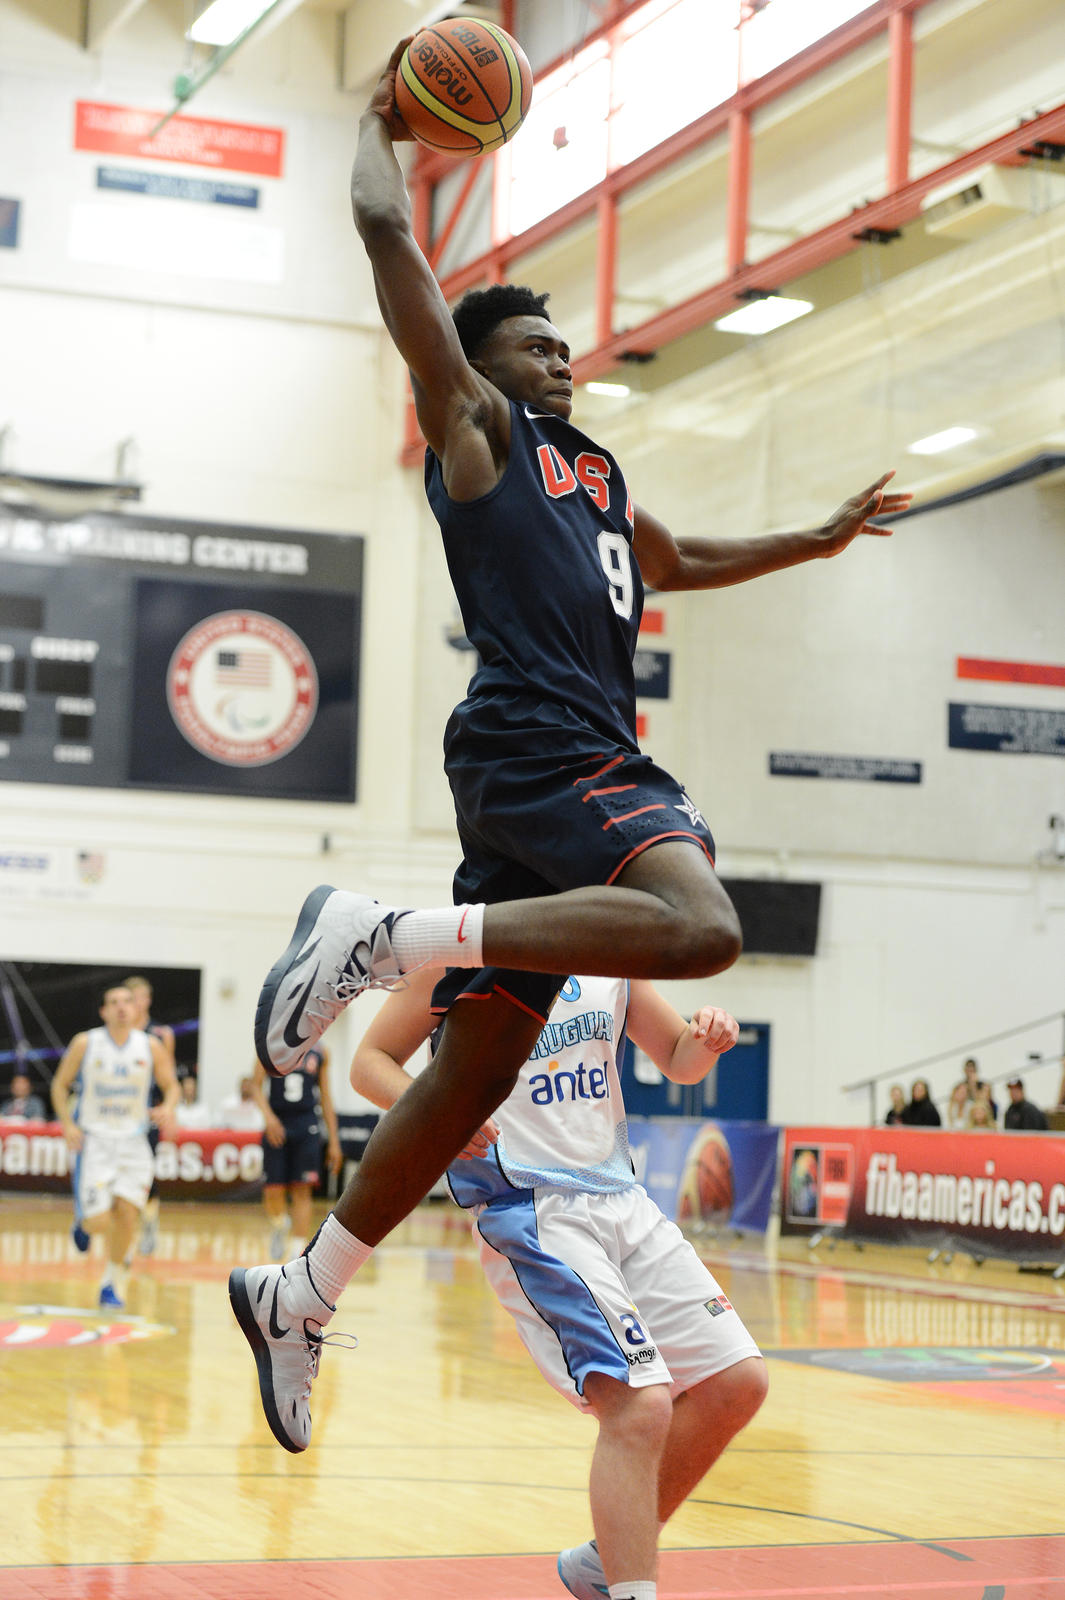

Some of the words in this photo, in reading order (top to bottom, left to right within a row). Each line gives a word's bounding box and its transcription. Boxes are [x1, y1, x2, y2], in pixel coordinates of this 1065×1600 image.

[431, 39, 468, 81] OFFICIAL
[451, 27, 485, 56] FIBA
[413, 39, 473, 105] molten
[49, 522, 189, 563] TRAINING
[193, 536, 307, 574] CENTER
[596, 530, 634, 621] 9
[528, 1011, 614, 1061] RUGUA
[528, 1061, 610, 1106] antel
